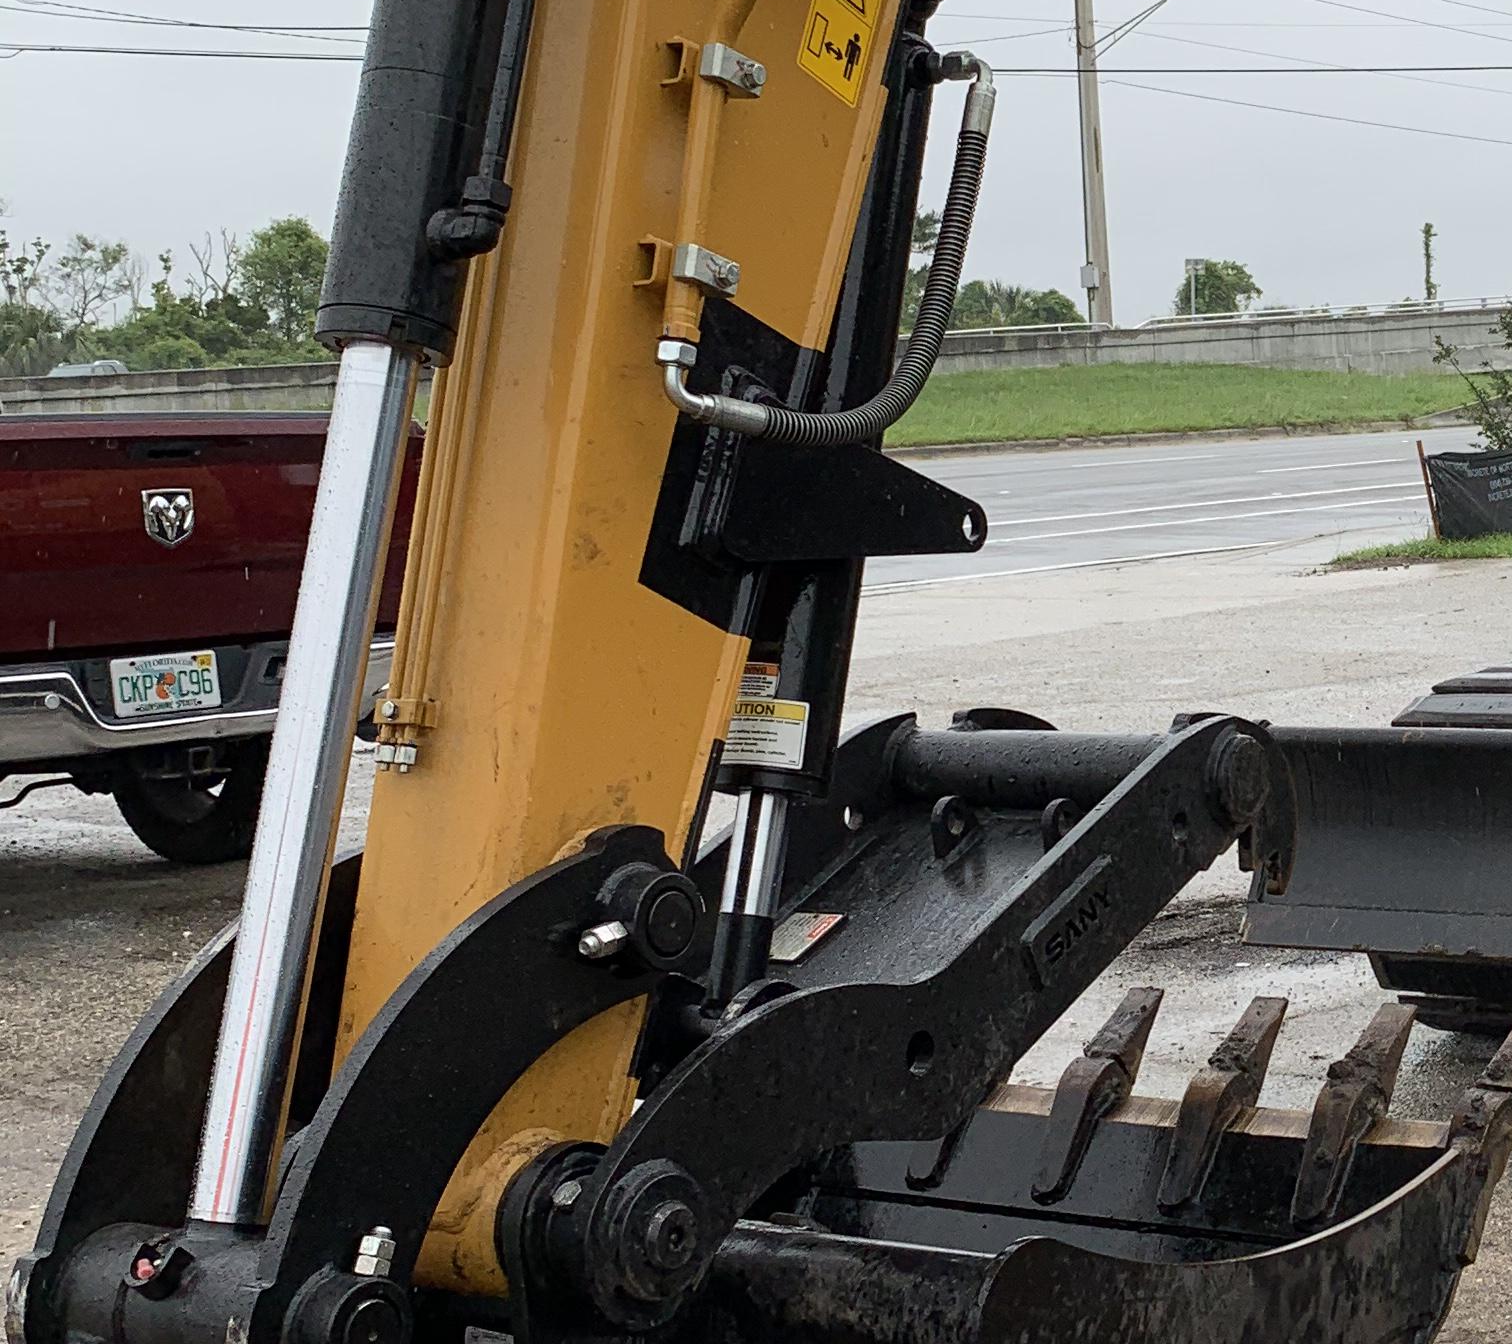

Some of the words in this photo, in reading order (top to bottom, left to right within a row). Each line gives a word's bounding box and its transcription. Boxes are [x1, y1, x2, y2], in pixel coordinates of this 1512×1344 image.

[119, 674, 153, 703] CKP
[178, 668, 213, 696] C96
[734, 703, 775, 715] UTION
[1045, 881, 1110, 963] SANY
